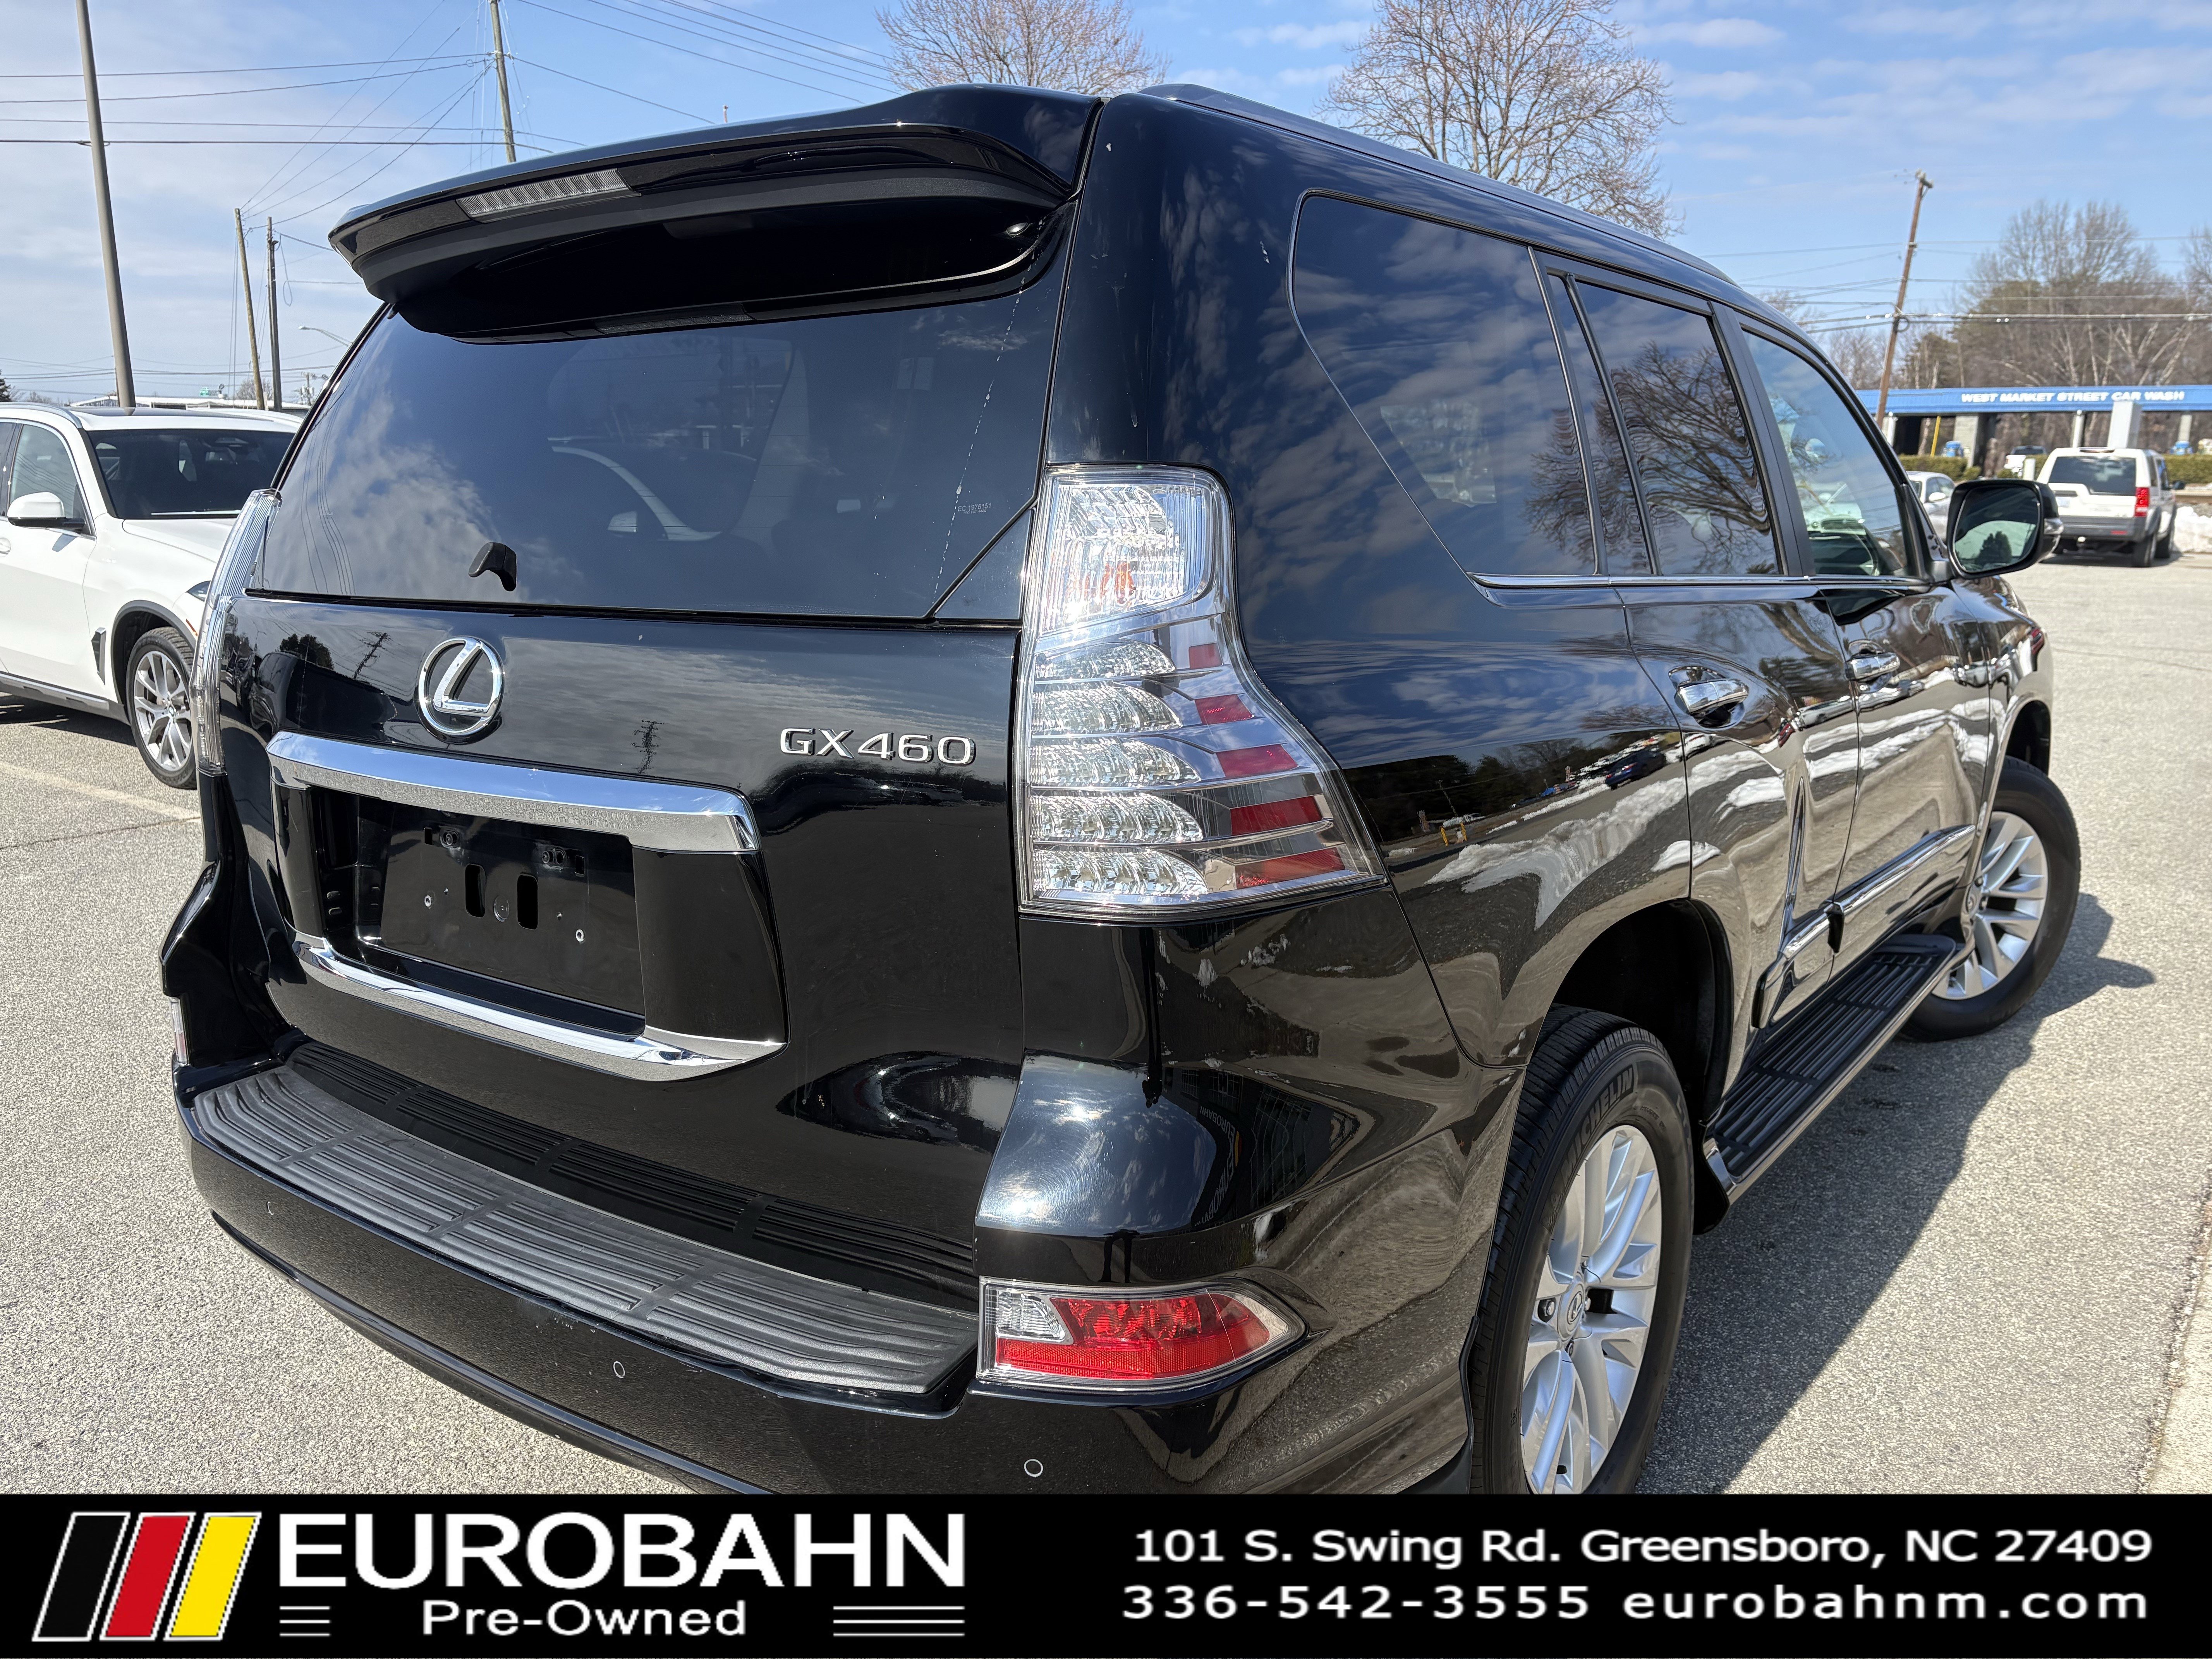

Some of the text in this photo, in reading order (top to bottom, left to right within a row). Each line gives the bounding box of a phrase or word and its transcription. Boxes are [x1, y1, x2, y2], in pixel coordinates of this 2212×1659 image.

[1961, 391, 2185, 403] WEST MARKET STREET CAR WASH
[1560, 1067, 1632, 1184] MICHELIN
